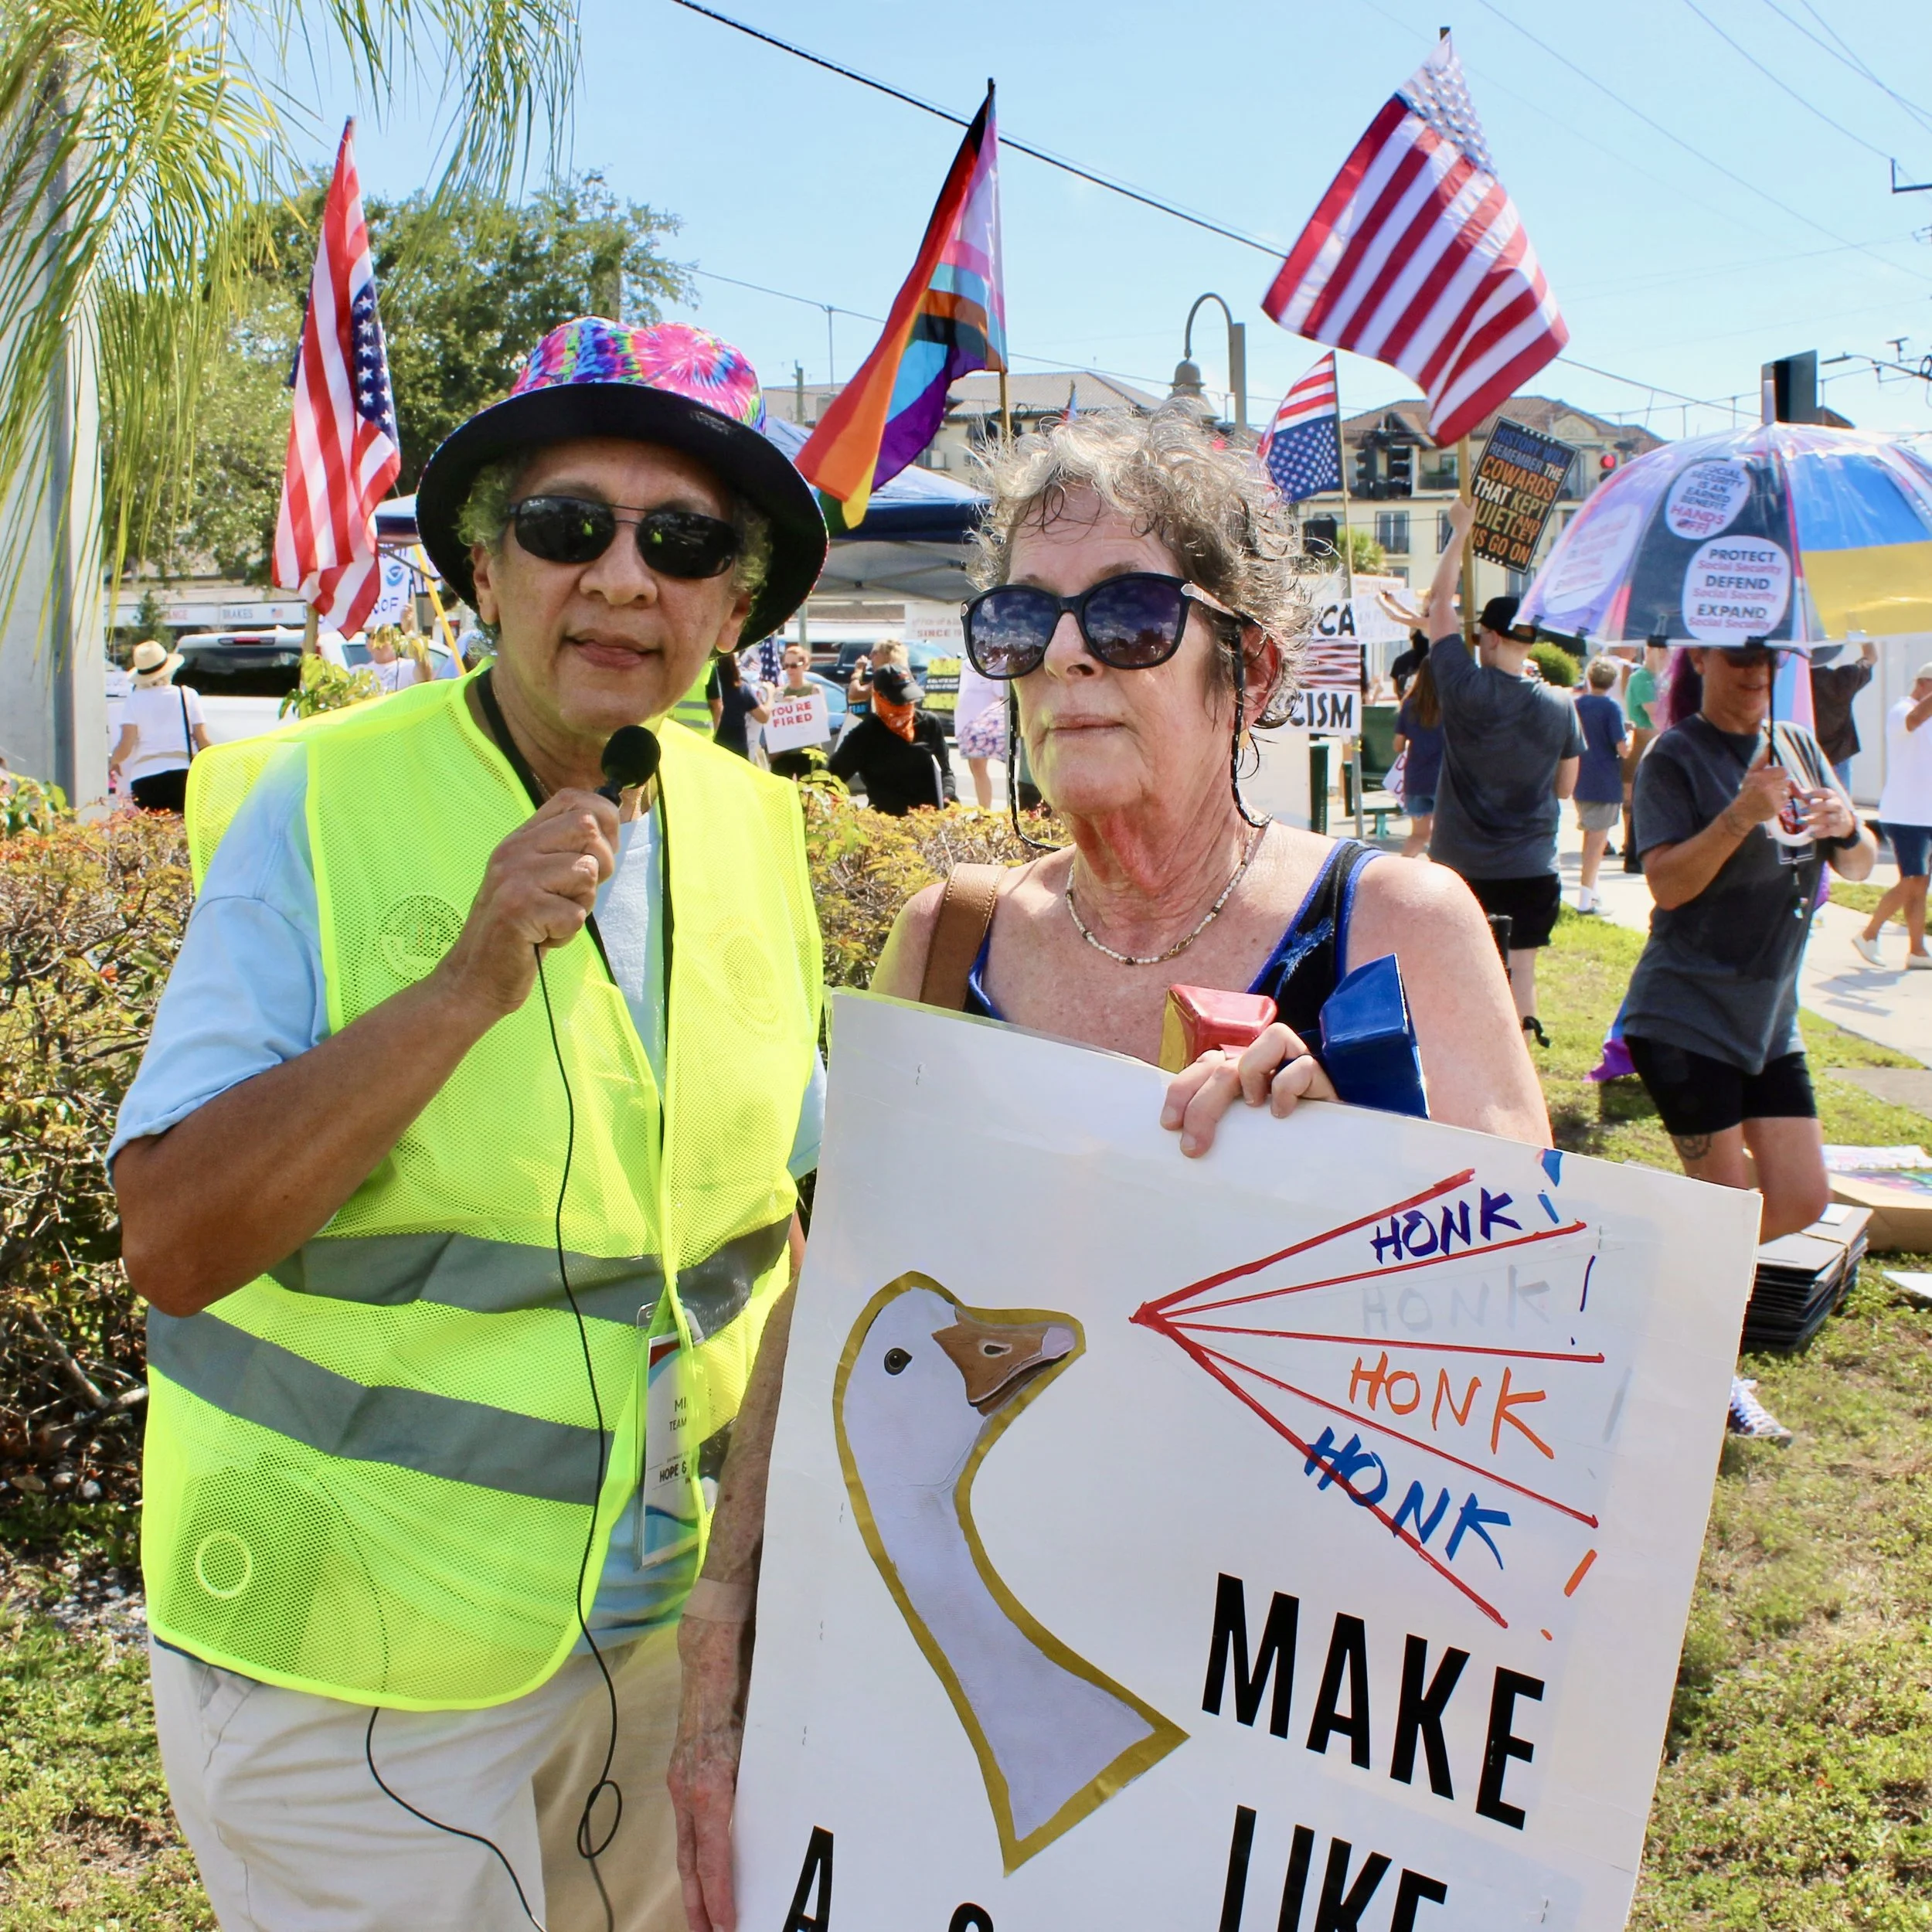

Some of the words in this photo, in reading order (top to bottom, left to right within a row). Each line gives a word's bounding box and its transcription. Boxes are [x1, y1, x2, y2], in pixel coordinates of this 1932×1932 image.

[1495, 427, 1543, 456] HISTORY
[1543, 447, 1568, 468] WILL
[1488, 442, 1544, 474] REMEMBER
[1544, 463, 1565, 482] THE
[1481, 456, 1559, 502] COWARDS
[1473, 476, 1512, 505] THAT
[1510, 489, 1549, 520] KEPT
[1475, 499, 1519, 535] UIET
[1516, 516, 1541, 532] AND
[1671, 505, 1726, 525] HANDS
[1510, 522, 1537, 544] LET
[1488, 533, 1509, 556] GO
[1509, 543, 1531, 565] ON
[1709, 549, 1777, 563] PROTECT
[1698, 560, 1731, 570] Social
[1734, 563, 1782, 576] Security
[1705, 575, 1770, 590] DEFEND
[1692, 587, 1728, 598] Social
[1730, 590, 1777, 603] Security
[1697, 604, 1767, 619] EXPAND
[917, 629, 951, 638] SINCE
[1689, 617, 1722, 628] Social
[1724, 619, 1772, 631] Security
[773, 713, 812, 728] FIRED
[659, 1463, 679, 1483] HOPE
[1202, 1572, 1546, 1831] MAKE
